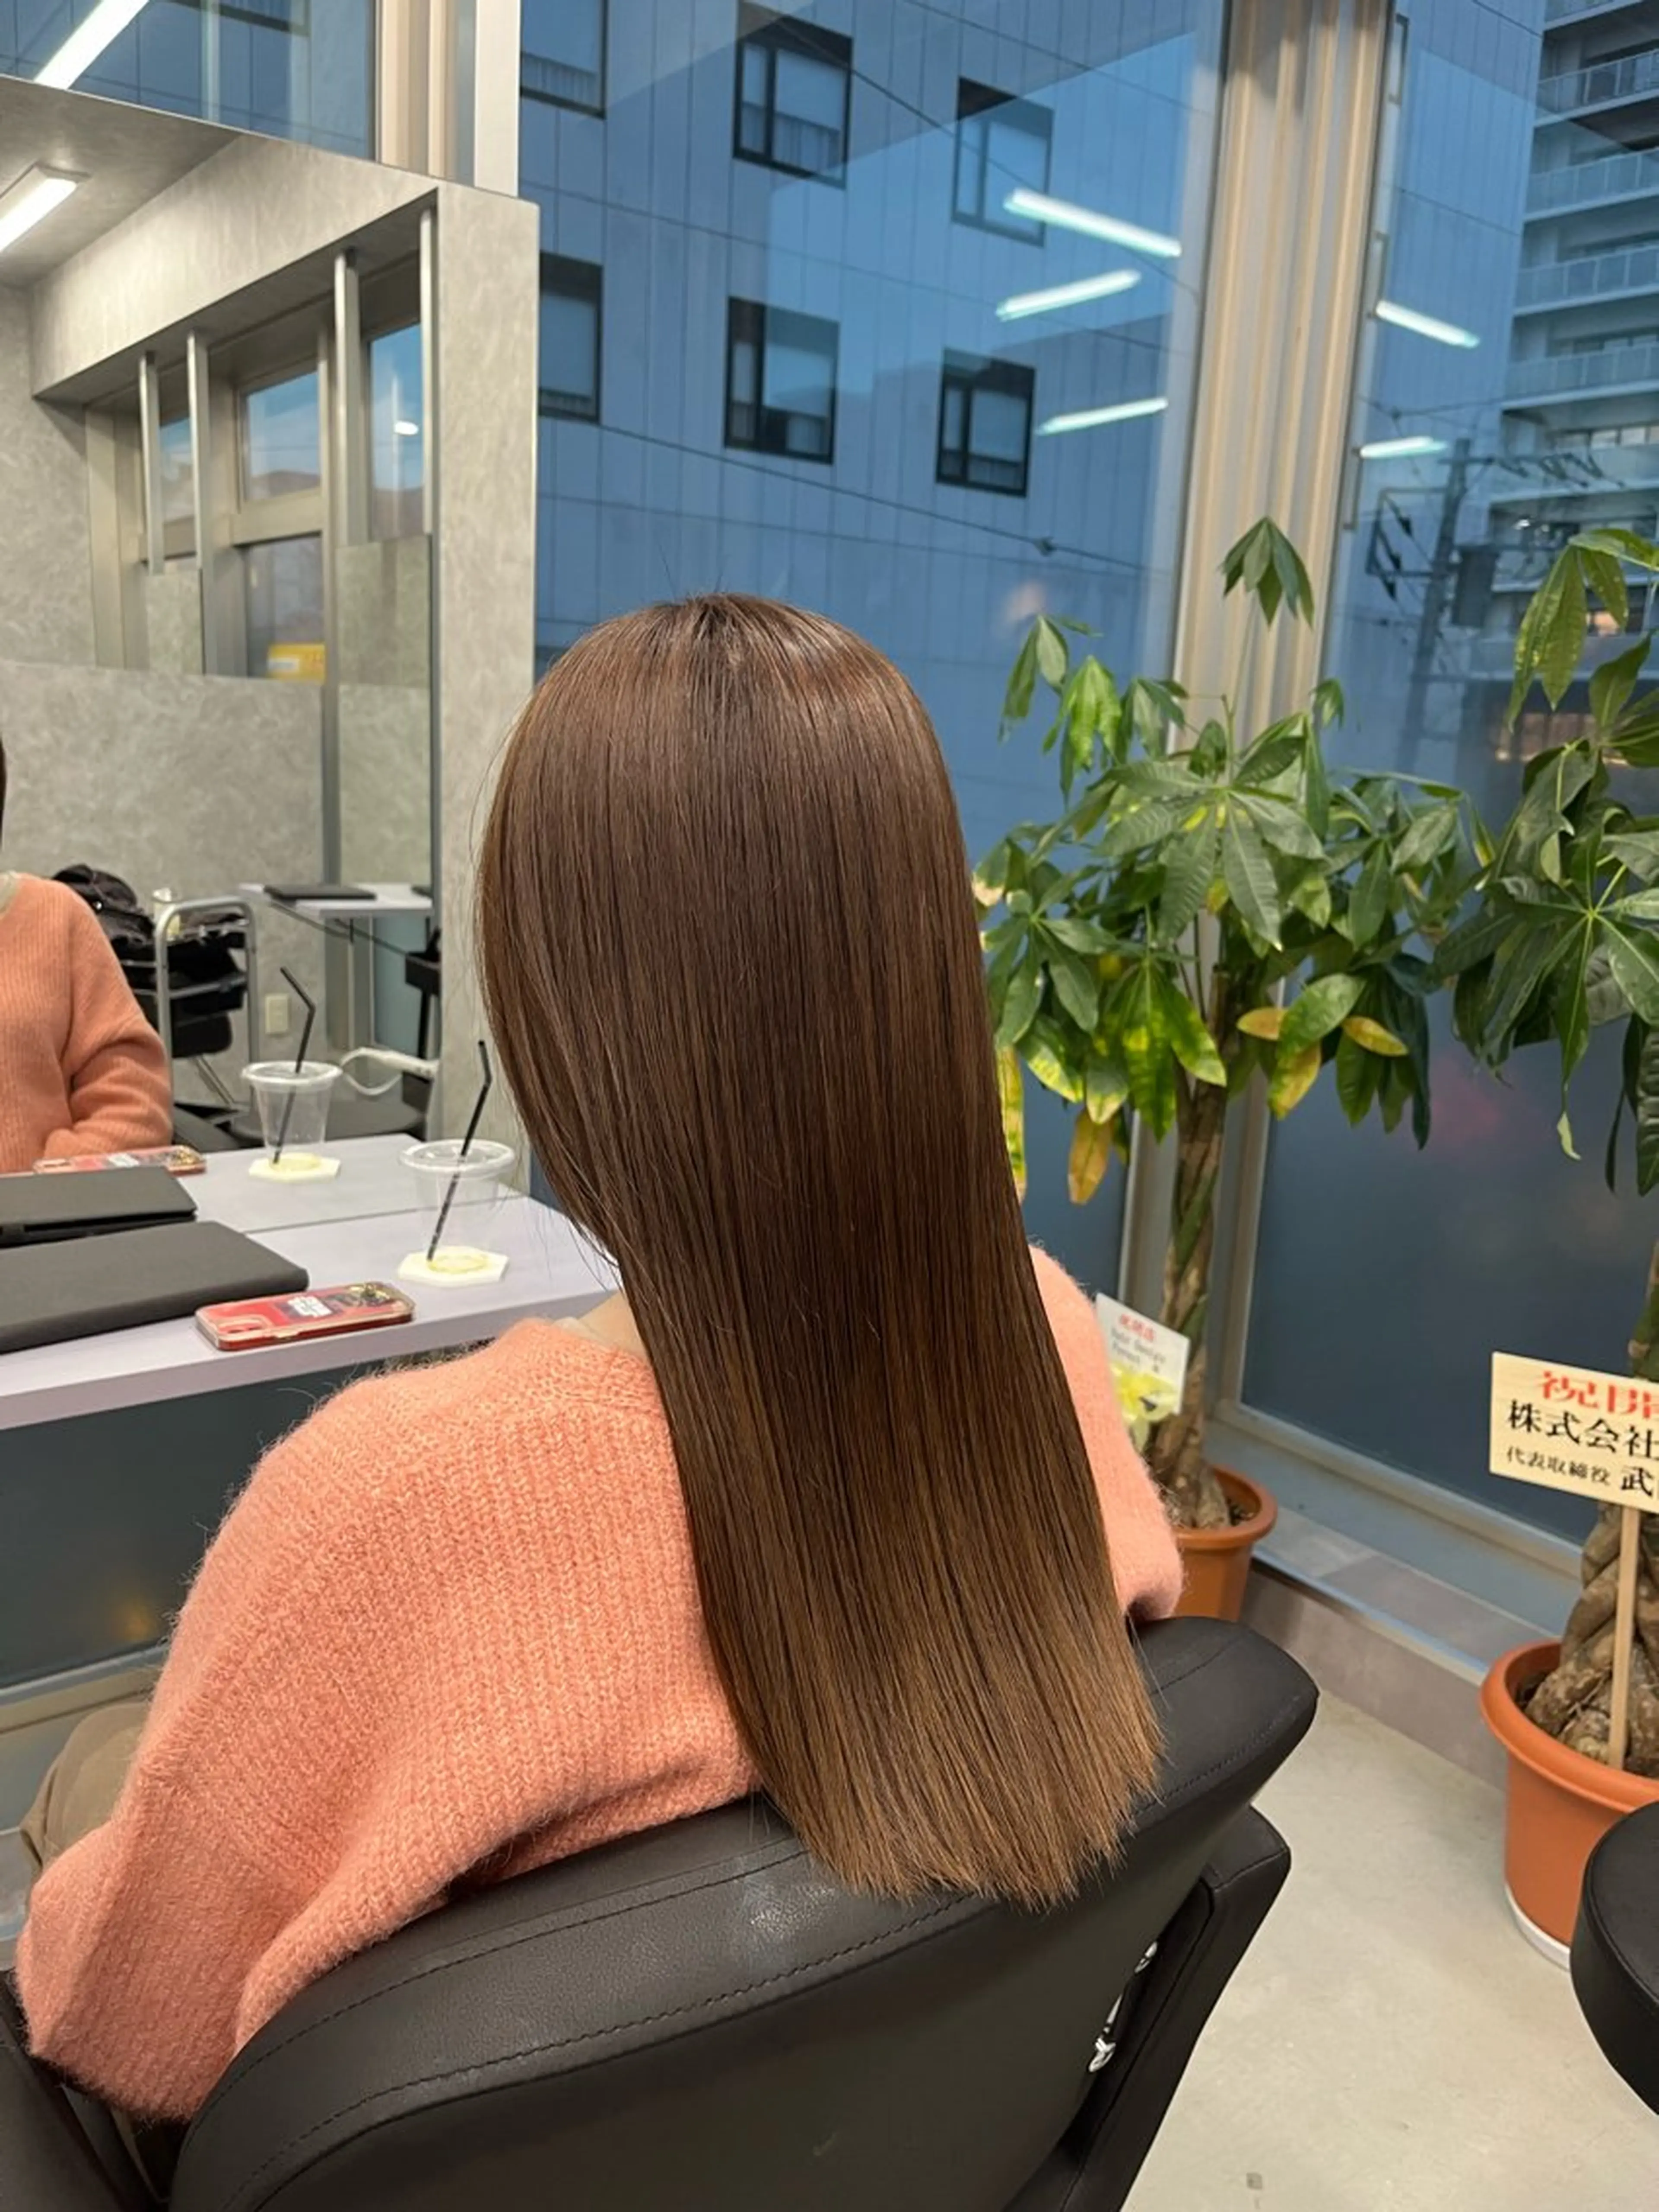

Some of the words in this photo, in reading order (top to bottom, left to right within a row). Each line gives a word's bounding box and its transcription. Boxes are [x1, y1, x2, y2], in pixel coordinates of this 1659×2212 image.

[1508, 1399, 1659, 1461] 株式会社
[1507, 1446, 1611, 1485] 代表取締役
[1620, 1466, 1659, 1497] 武
